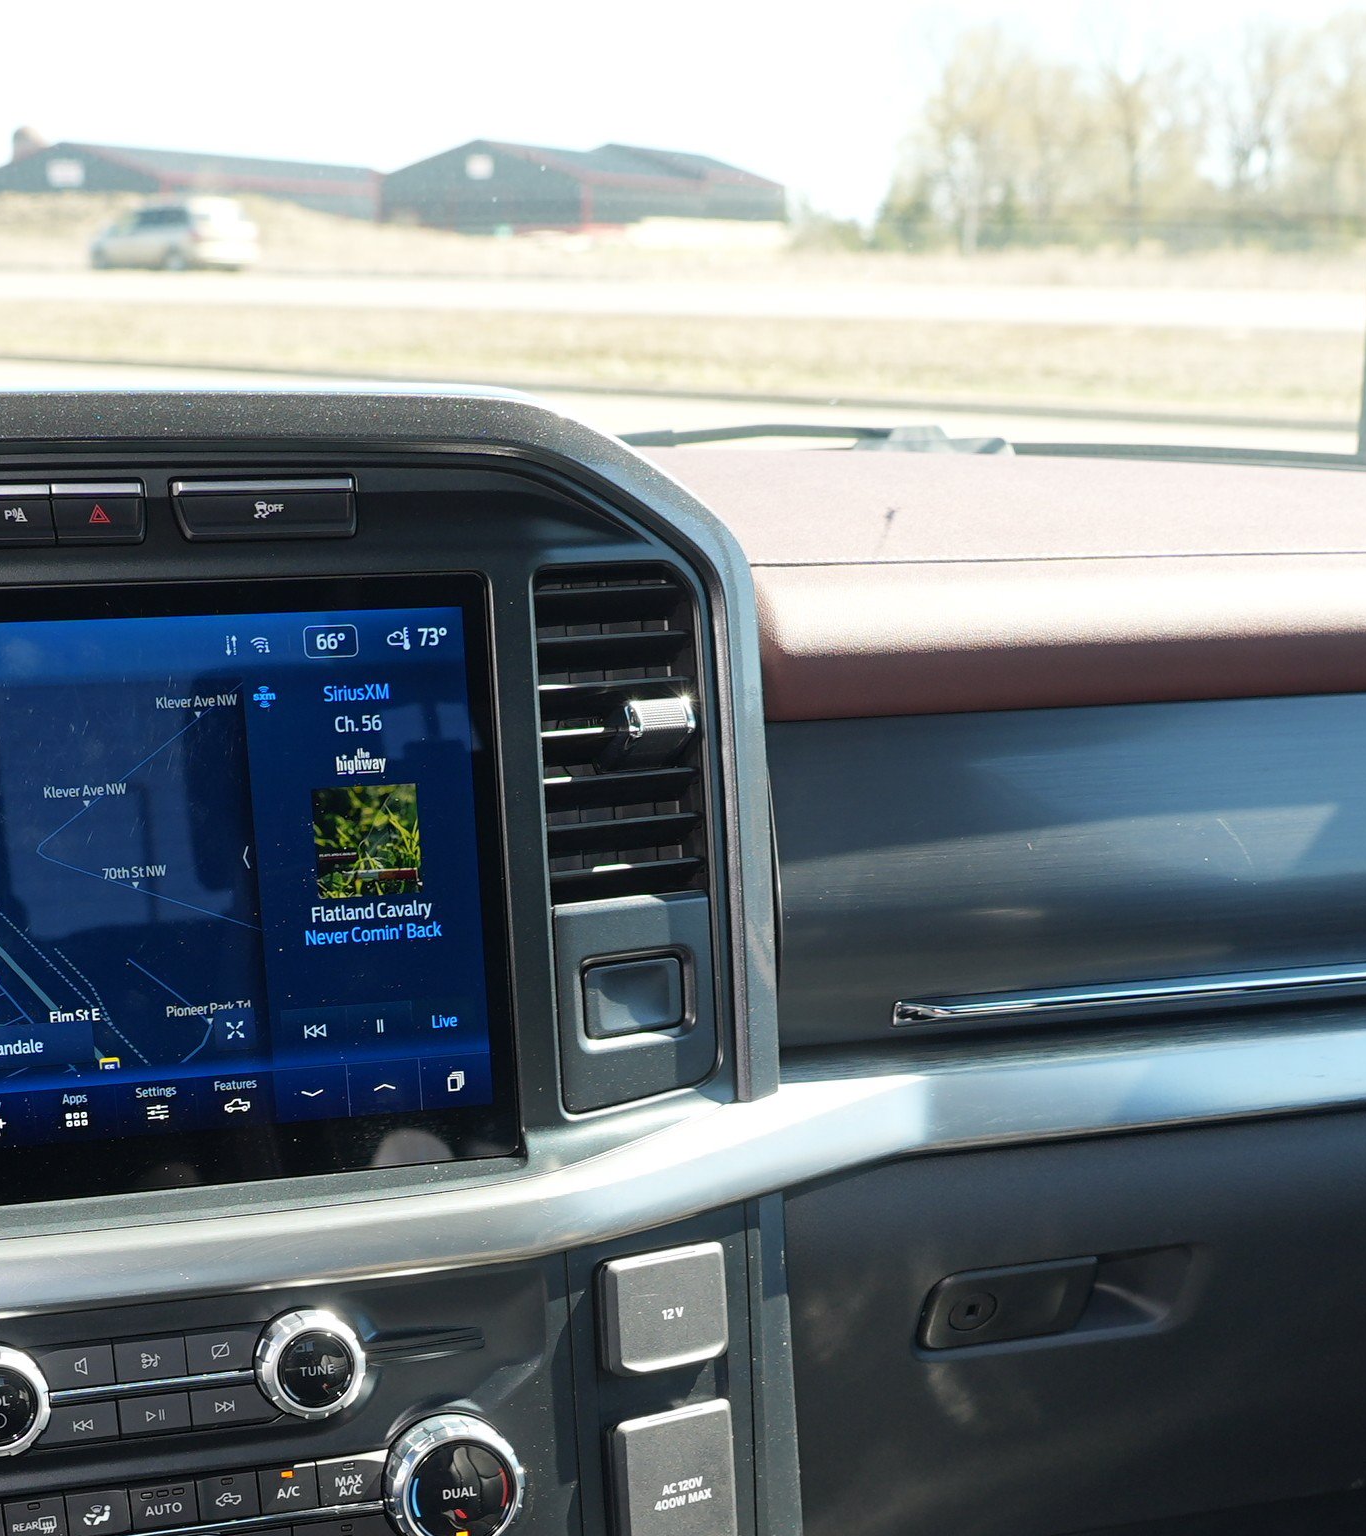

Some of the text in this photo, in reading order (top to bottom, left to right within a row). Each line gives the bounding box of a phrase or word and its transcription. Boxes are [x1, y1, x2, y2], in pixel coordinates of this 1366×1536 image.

[267, 503, 285, 513] OFF
[315, 632, 346, 651] 66°
[417, 627, 447, 647] 73°
[323, 682, 390, 702] SiriusXM
[155, 693, 237, 710] Klever Ave NW
[334, 714, 382, 733] Ch. 56
[357, 748, 370, 760] the
[335, 753, 387, 775] highway
[43, 782, 127, 800] Klever Ave NW
[102, 864, 167, 880] 70th St NW
[311, 901, 433, 923] Flatland Cavalry
[304, 922, 443, 946] Never Comin' Back
[49, 1008, 101, 1023] Elm St E
[166, 1005, 209, 1018] Pioneer
[431, 1014, 458, 1029] Live
[135, 1084, 176, 1099] Settings
[213, 1077, 257, 1092] Features
[62, 1092, 88, 1106] Apps
[299, 1364, 335, 1377] TUNE
[334, 1474, 363, 1488] MAX
[662, 1475, 704, 1496] AC 120V
[276, 1485, 301, 1499] A/C
[338, 1482, 363, 1498] A/C
[442, 1485, 477, 1500] DUAL
[654, 1487, 713, 1513] 400W MAX
[145, 1502, 183, 1517] AUTO
[12, 1520, 39, 1533] REAR
